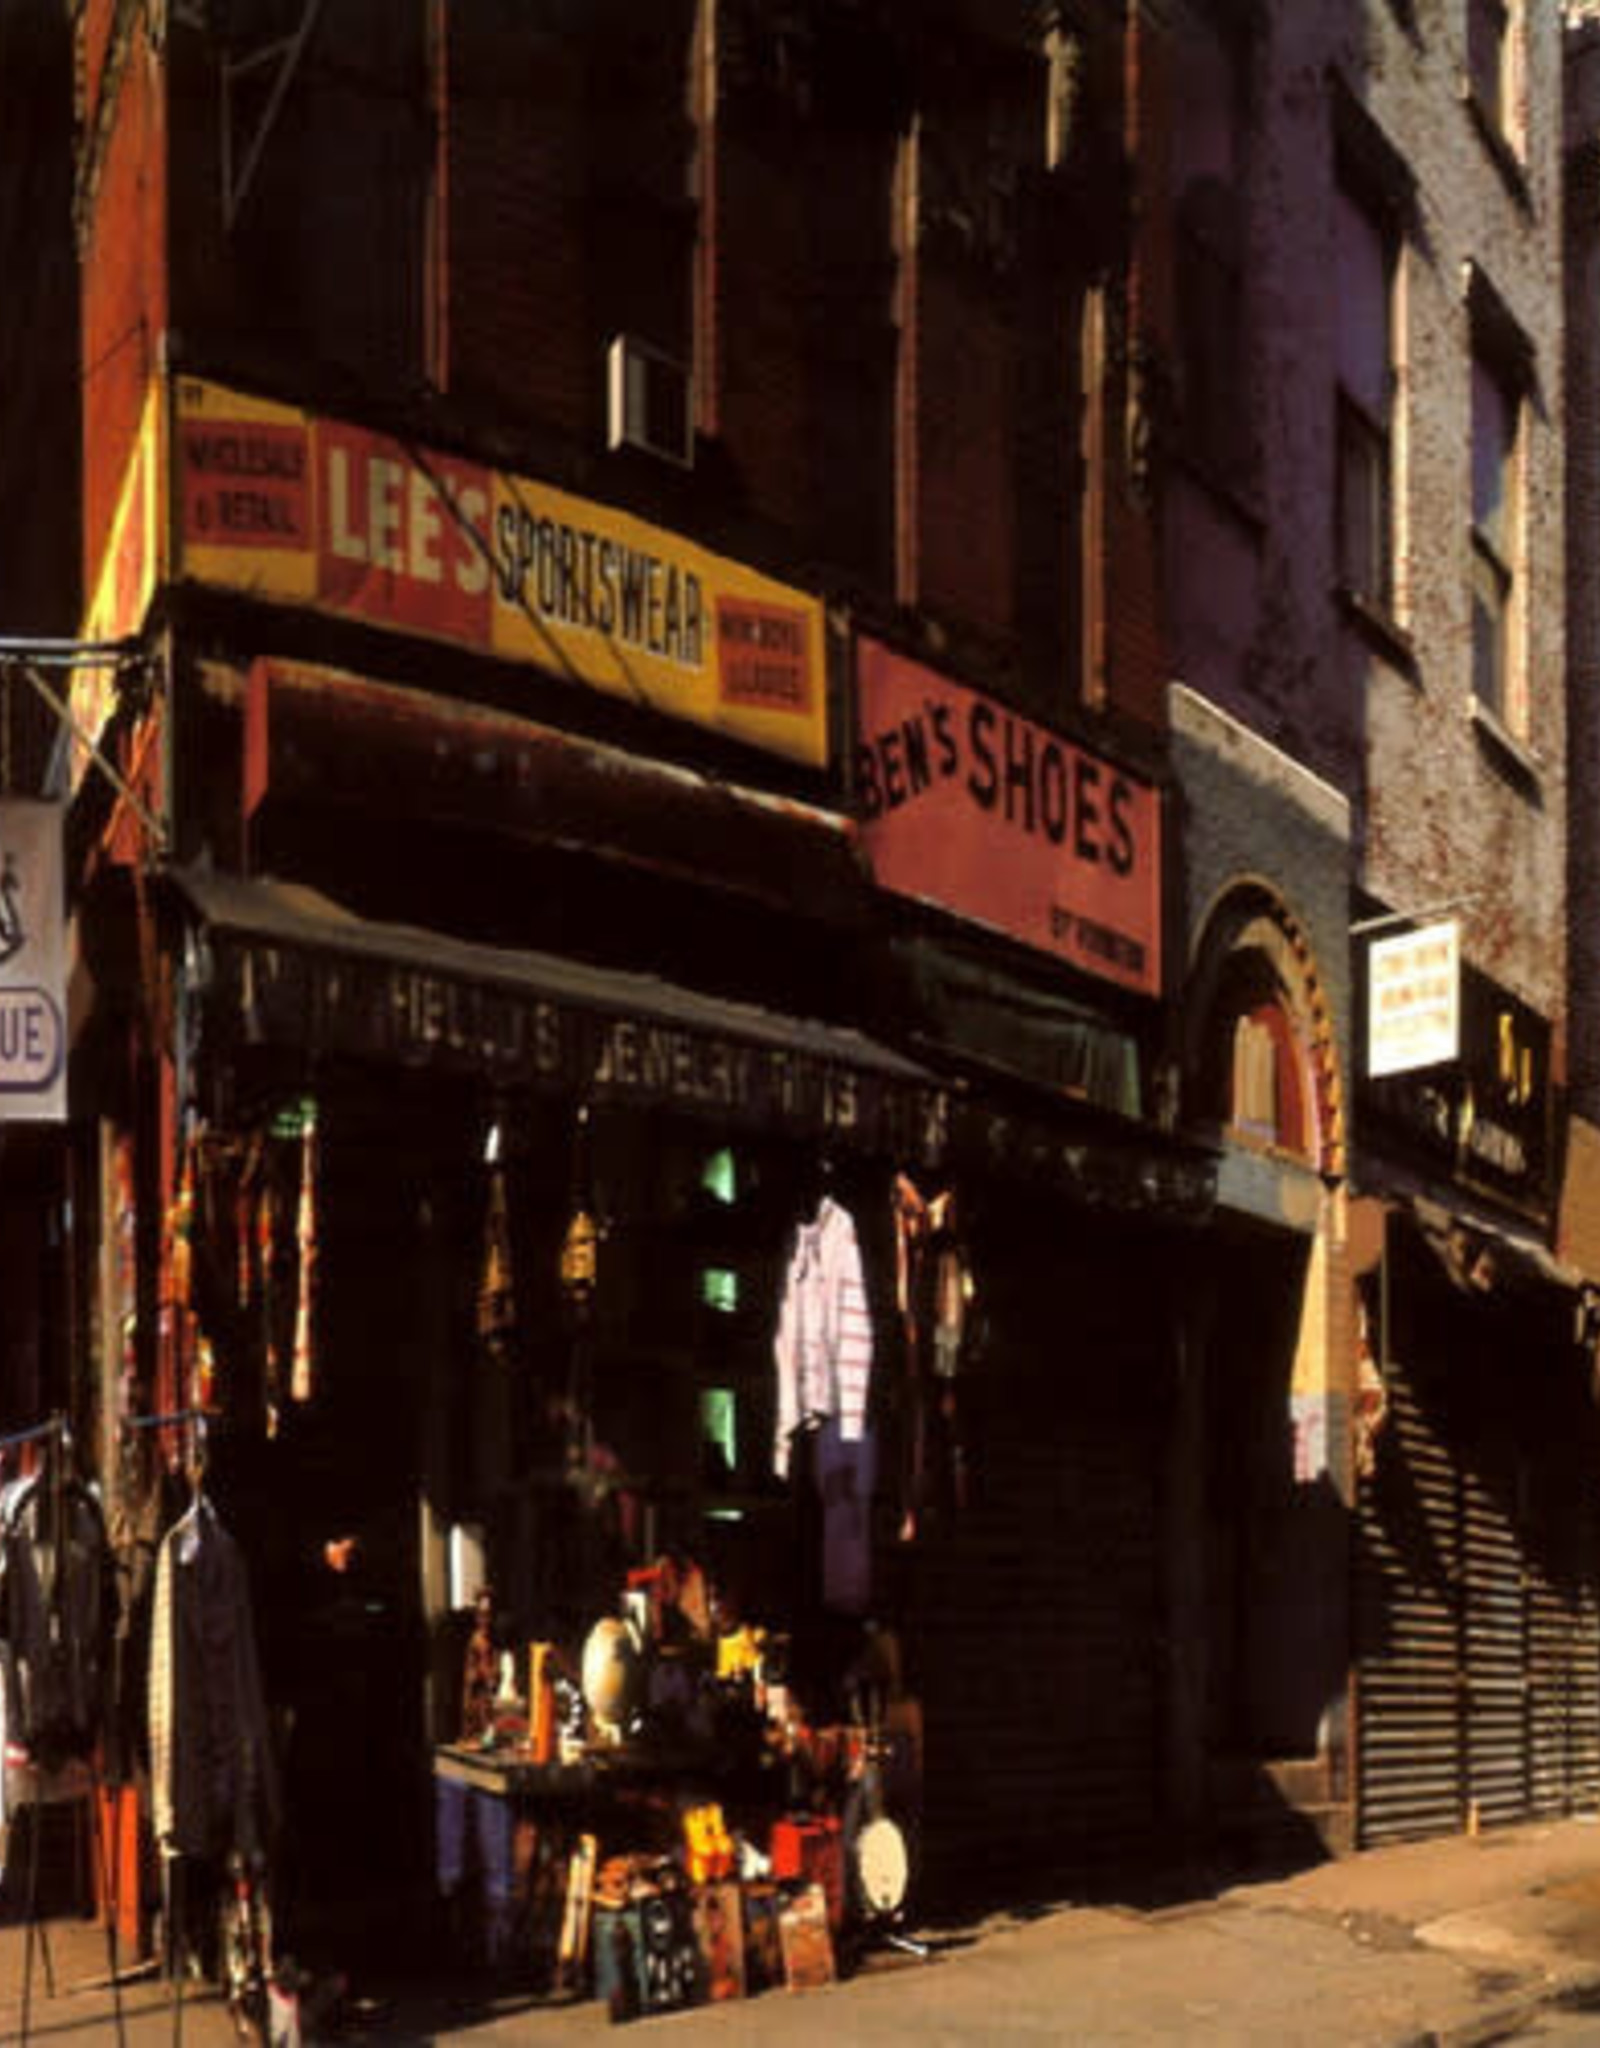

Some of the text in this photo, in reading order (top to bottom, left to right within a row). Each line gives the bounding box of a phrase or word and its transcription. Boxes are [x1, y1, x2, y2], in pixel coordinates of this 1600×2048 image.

[329, 446, 707, 668] LEE'S SPORTSWEAR
[855, 698, 1136, 877] BEN'S SHOES
